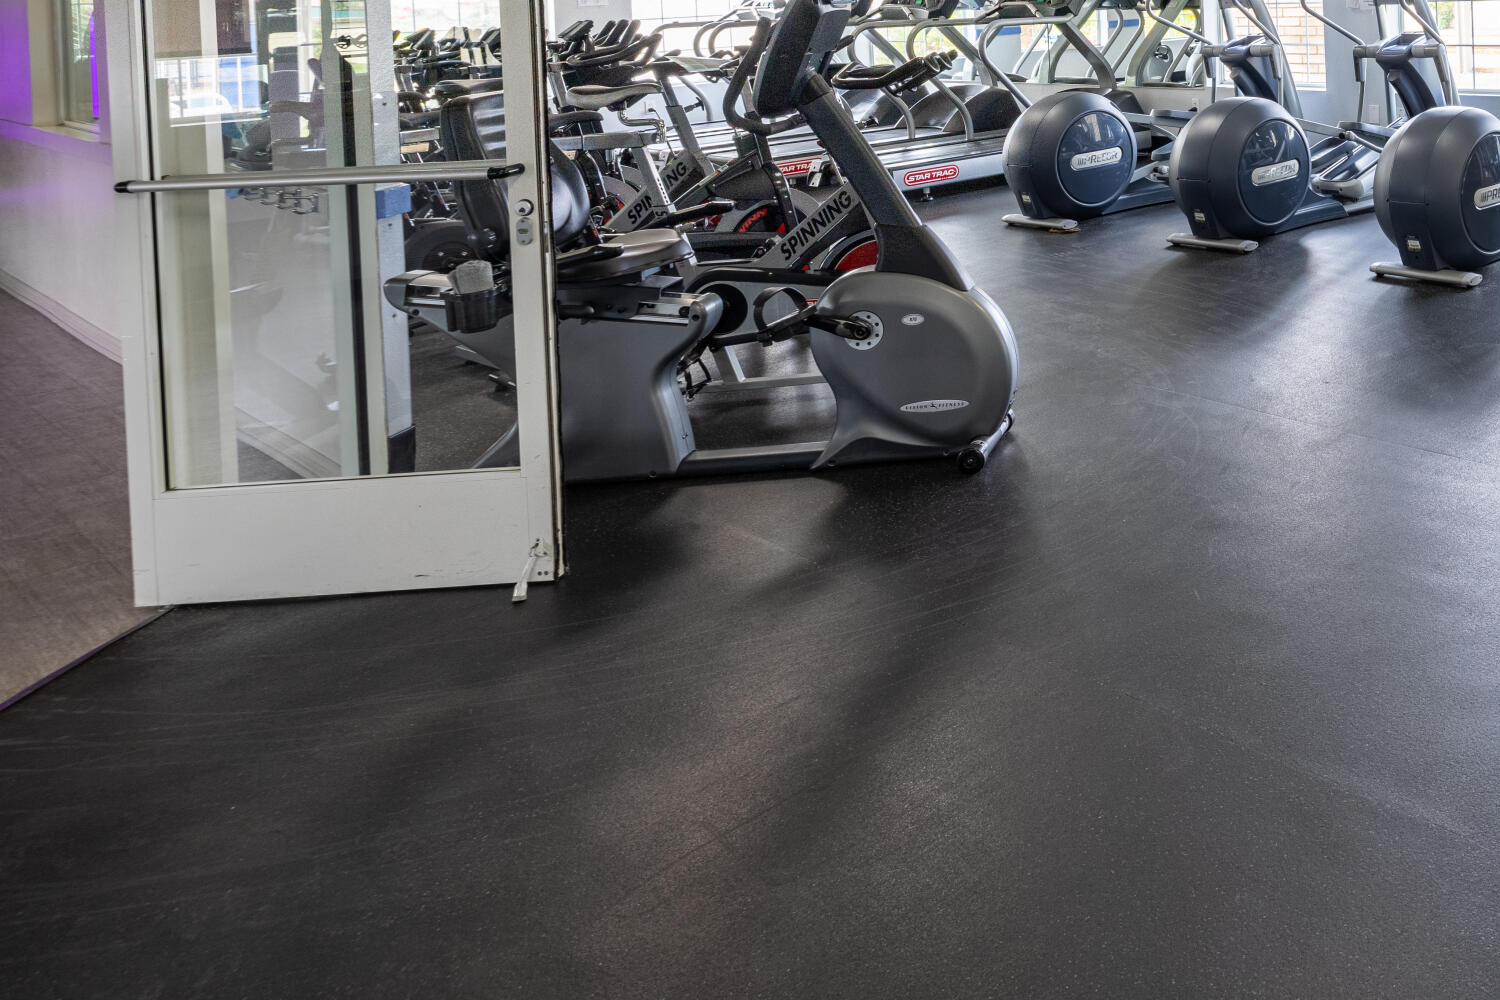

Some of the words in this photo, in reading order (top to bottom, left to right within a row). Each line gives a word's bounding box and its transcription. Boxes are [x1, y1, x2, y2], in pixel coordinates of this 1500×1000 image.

[908, 174, 931, 182] STAR
[932, 168, 956, 179] TRAC
[781, 191, 851, 260] SPINNING
